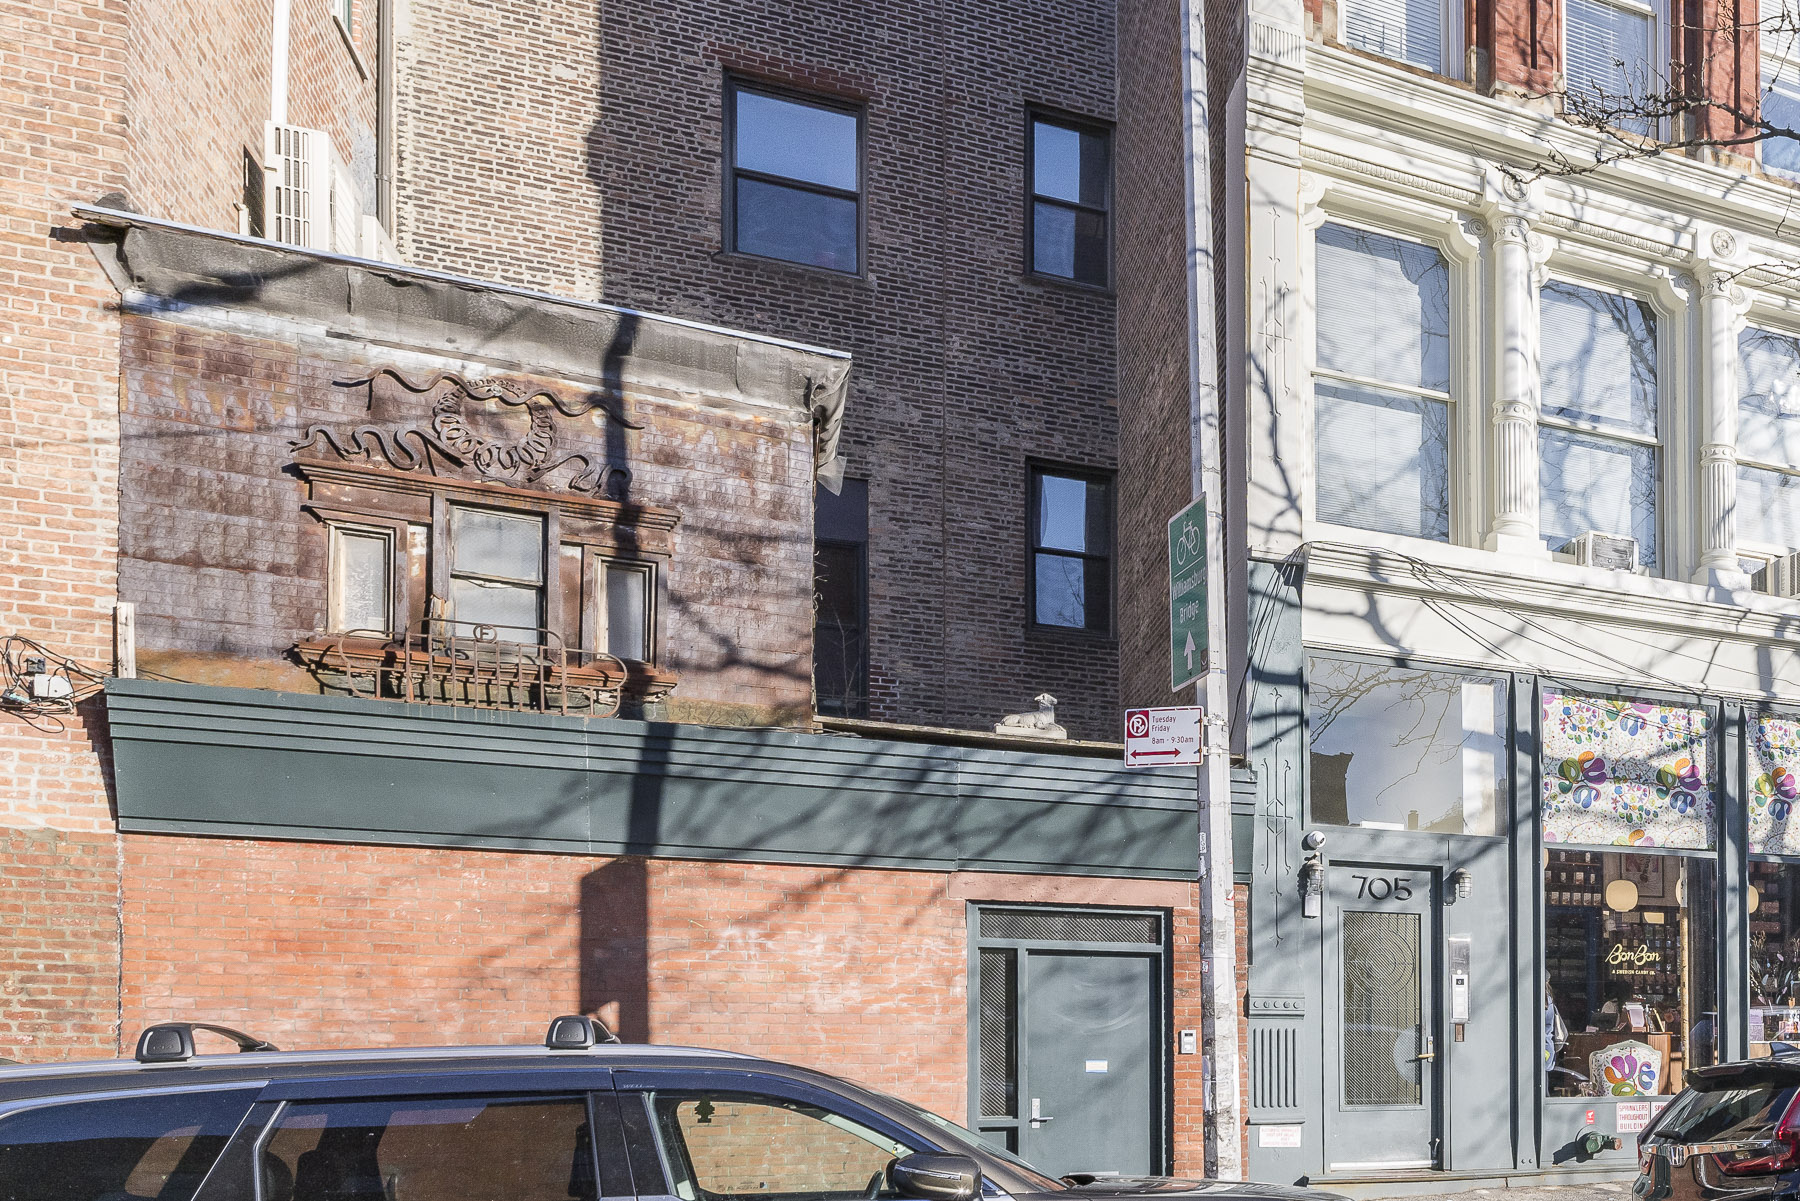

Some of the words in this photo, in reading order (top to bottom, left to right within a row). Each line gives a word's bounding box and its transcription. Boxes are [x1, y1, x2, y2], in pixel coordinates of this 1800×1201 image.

[1172, 566, 1206, 601] Williamsburg
[1179, 600, 1199, 624] Bridge
[1151, 724, 1171, 733] Friday
[1152, 715, 1177, 724] Tuesday
[1170, 735, 1194, 744] 9:30am
[1351, 874, 1413, 901] 705
[1604, 943, 1661, 966] BonBon
